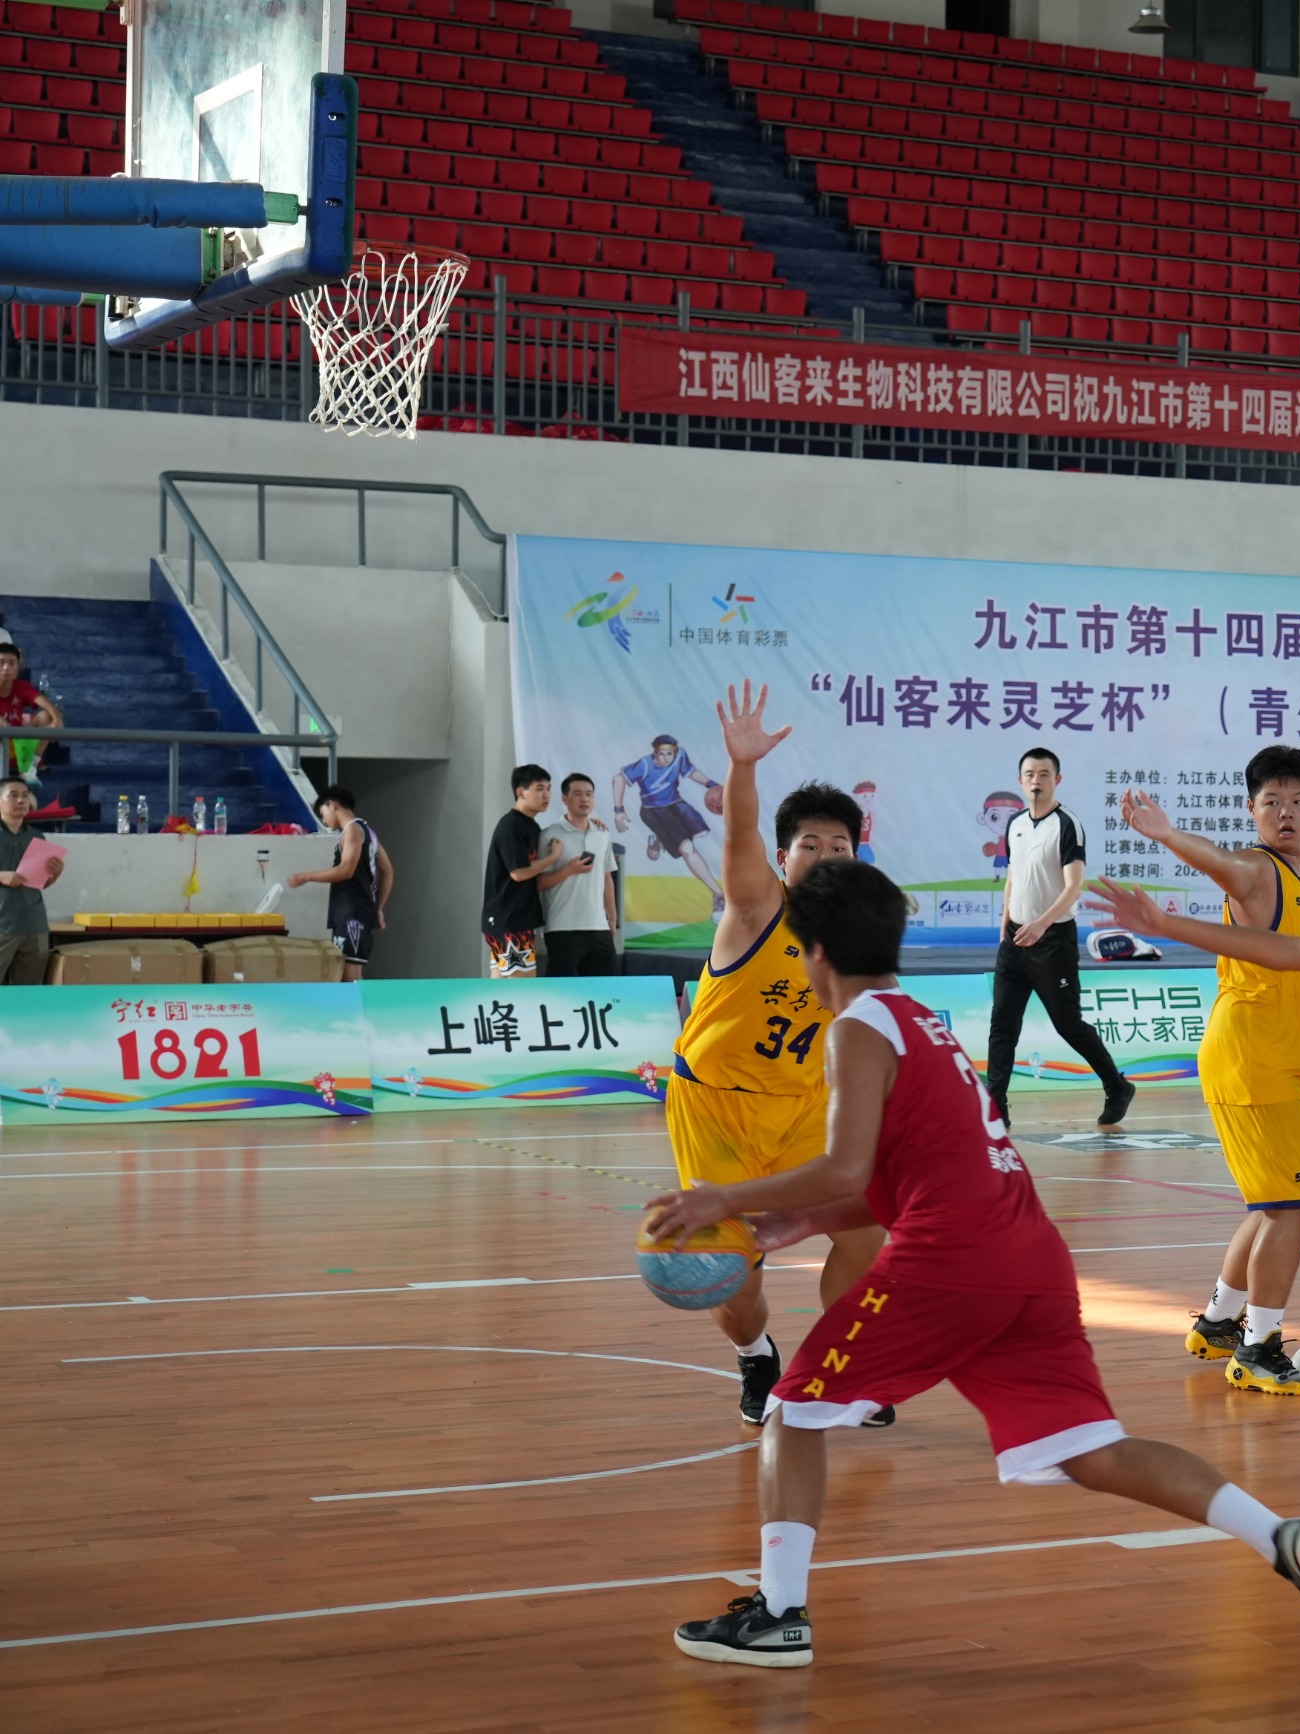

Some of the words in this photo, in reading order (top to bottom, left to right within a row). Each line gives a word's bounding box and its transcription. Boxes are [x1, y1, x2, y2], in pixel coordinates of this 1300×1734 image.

[679, 626, 789, 647] 中国体育彩票
[427, 1000, 619, 1055] 上峰上水
[754, 1015, 822, 1065] 34
[117, 1027, 261, 1080] 1821
